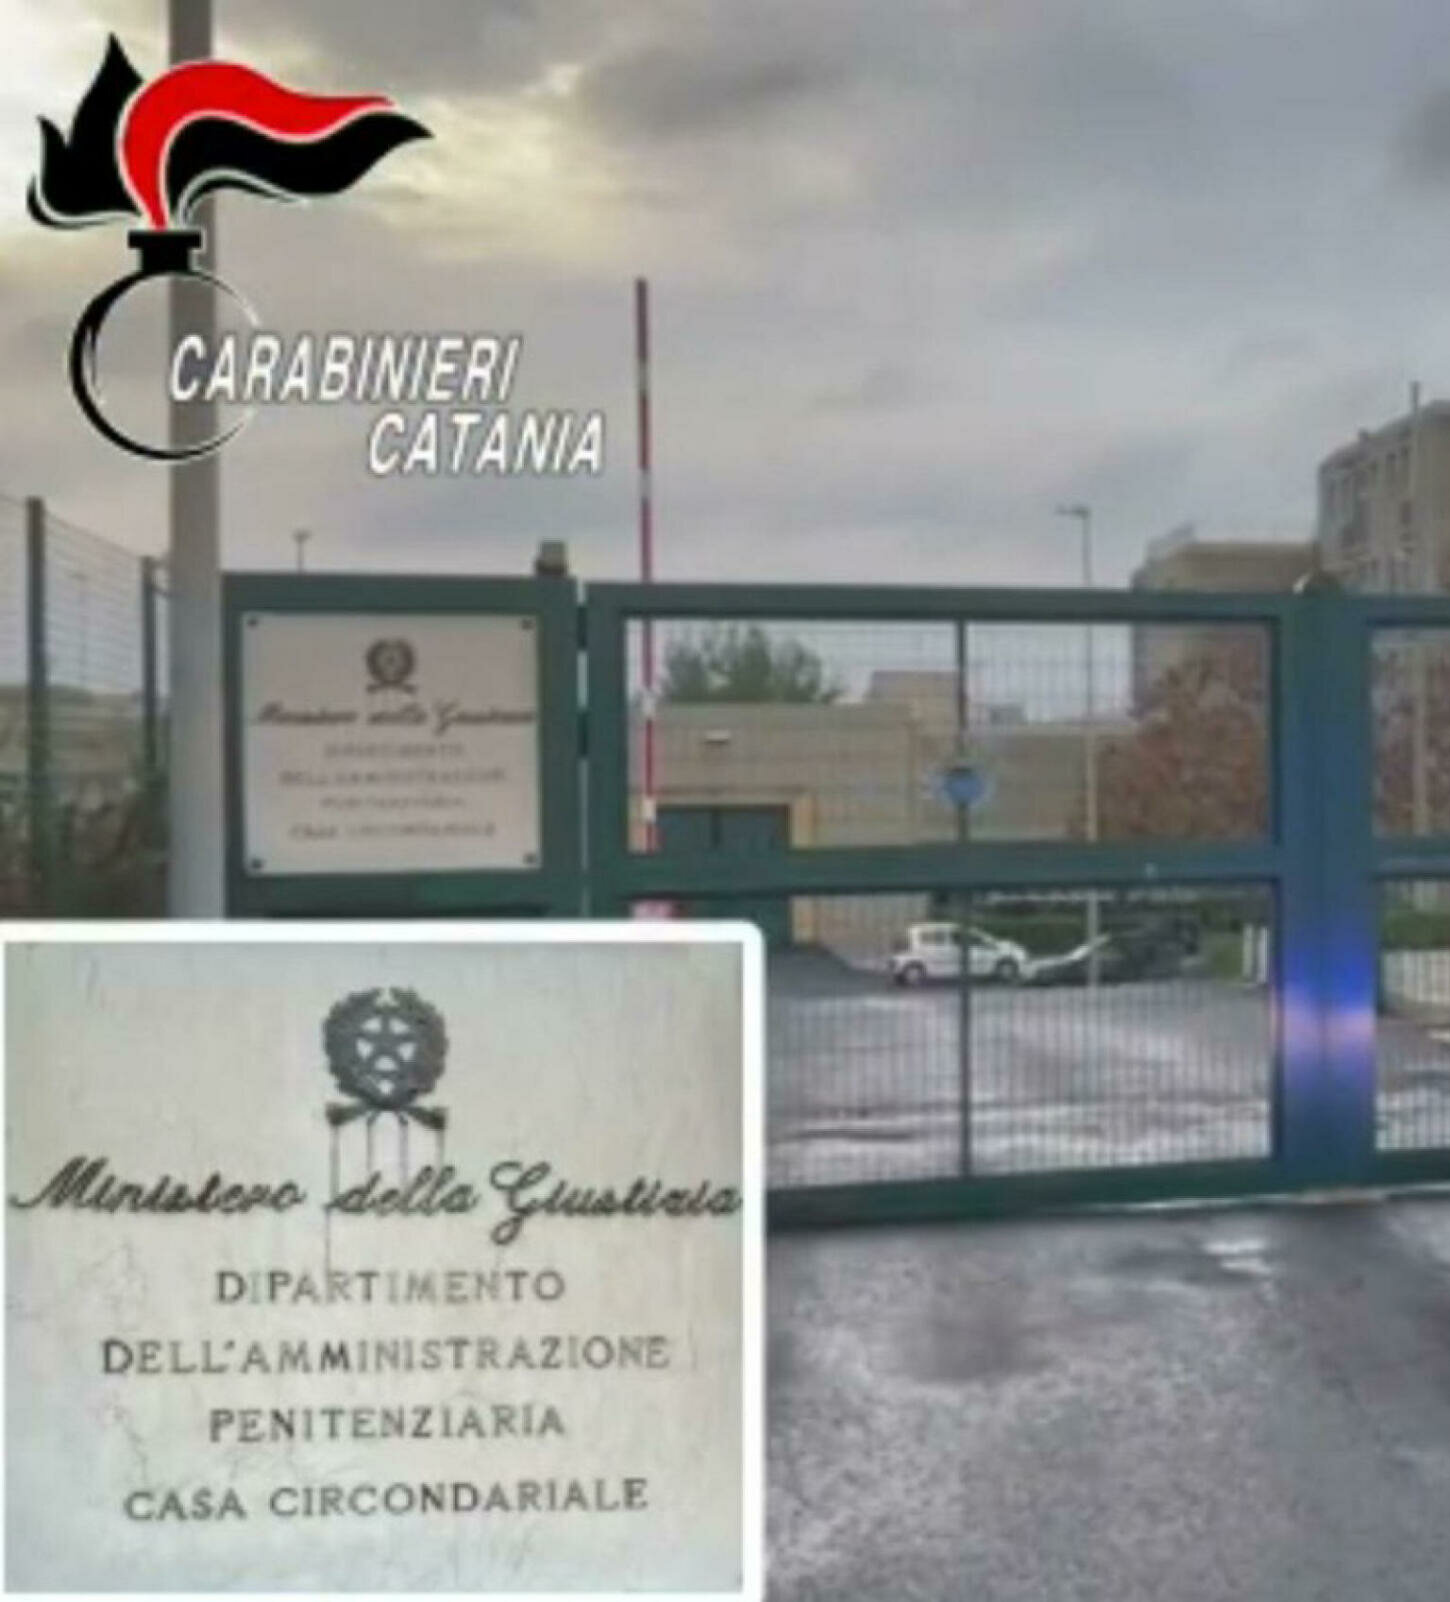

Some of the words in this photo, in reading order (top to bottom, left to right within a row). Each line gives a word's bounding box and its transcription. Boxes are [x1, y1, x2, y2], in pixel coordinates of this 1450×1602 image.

[14, 1156, 306, 1216] Ministero
[322, 1165, 480, 1217] della
[490, 1160, 744, 1244] Giustizia
[216, 1269, 567, 1305] DIPARTIMENTO
[102, 1335, 671, 1375] DELL'AMMINISTRAZIONE
[209, 1404, 565, 1443] PENITENZIARIA
[124, 1488, 246, 1522] CASA
[269, 1478, 649, 1519] CIRCONDARIALE
